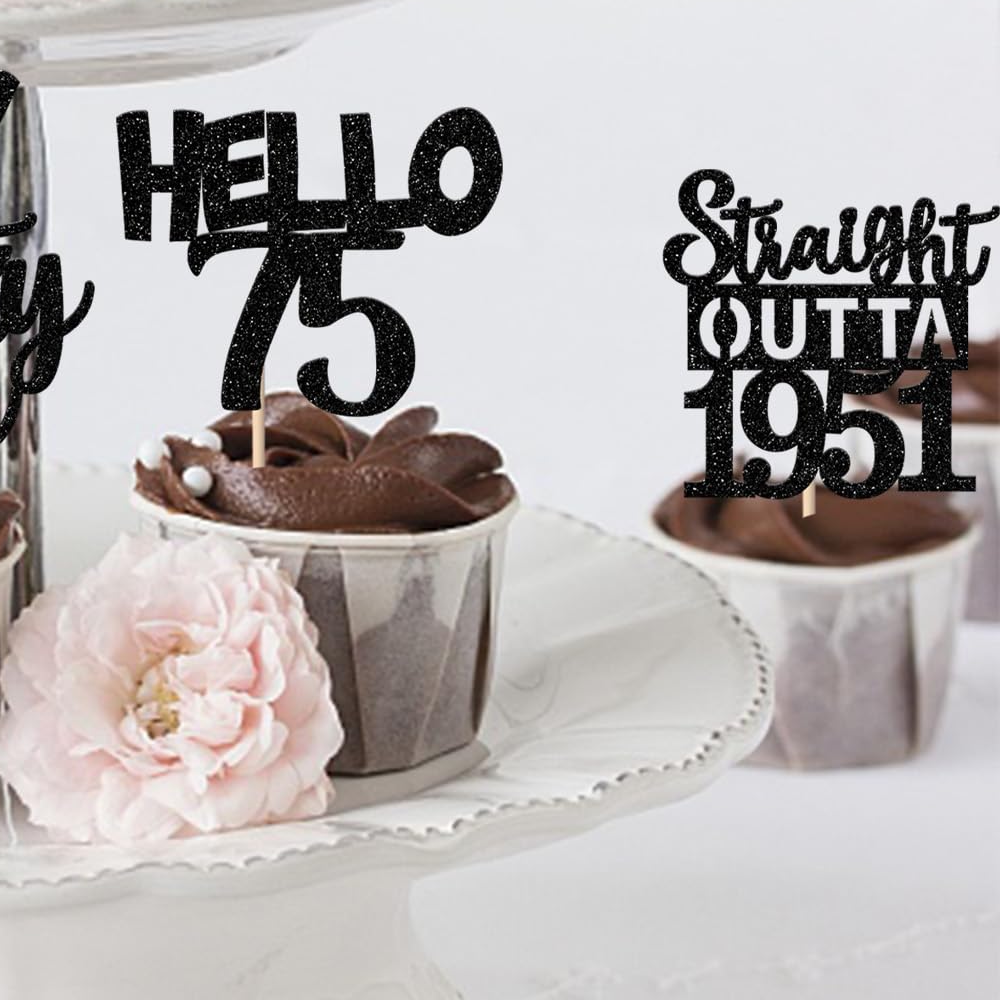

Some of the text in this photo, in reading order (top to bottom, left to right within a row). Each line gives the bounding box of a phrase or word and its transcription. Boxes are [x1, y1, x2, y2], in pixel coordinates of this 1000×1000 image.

[115, 106, 503, 243] HELLO
[662, 168, 1000, 287] Straight
[187, 230, 416, 418] 75
[699, 296, 957, 360] OUTTA
[683, 368, 977, 500] 1951
